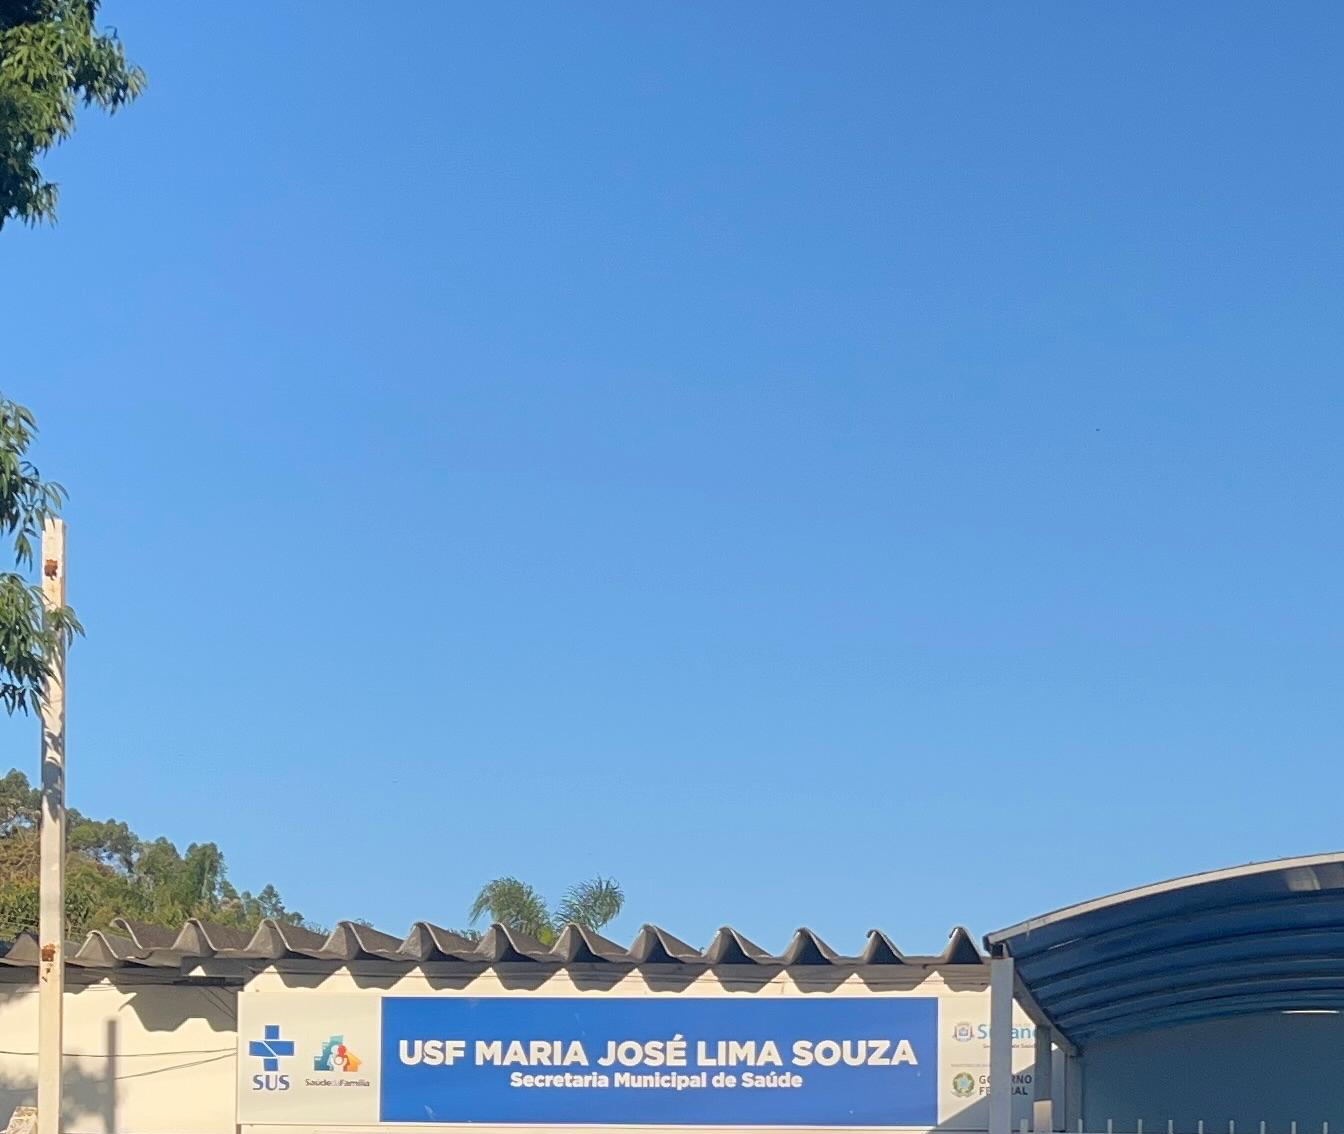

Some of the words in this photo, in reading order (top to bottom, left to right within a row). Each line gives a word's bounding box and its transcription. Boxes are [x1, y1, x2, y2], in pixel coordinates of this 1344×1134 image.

[399, 1039, 466, 1066] USF
[475, 1040, 590, 1067] MARIA
[596, 1034, 688, 1067] JOSÉ
[697, 1040, 784, 1067] LIMA
[791, 1039, 919, 1067] SOUZA
[252, 1074, 291, 1091] SUS
[510, 1071, 610, 1088] Secretaria
[613, 1071, 708, 1091] Municipal
[711, 1071, 738, 1088] de
[741, 1070, 804, 1088] Saúde
